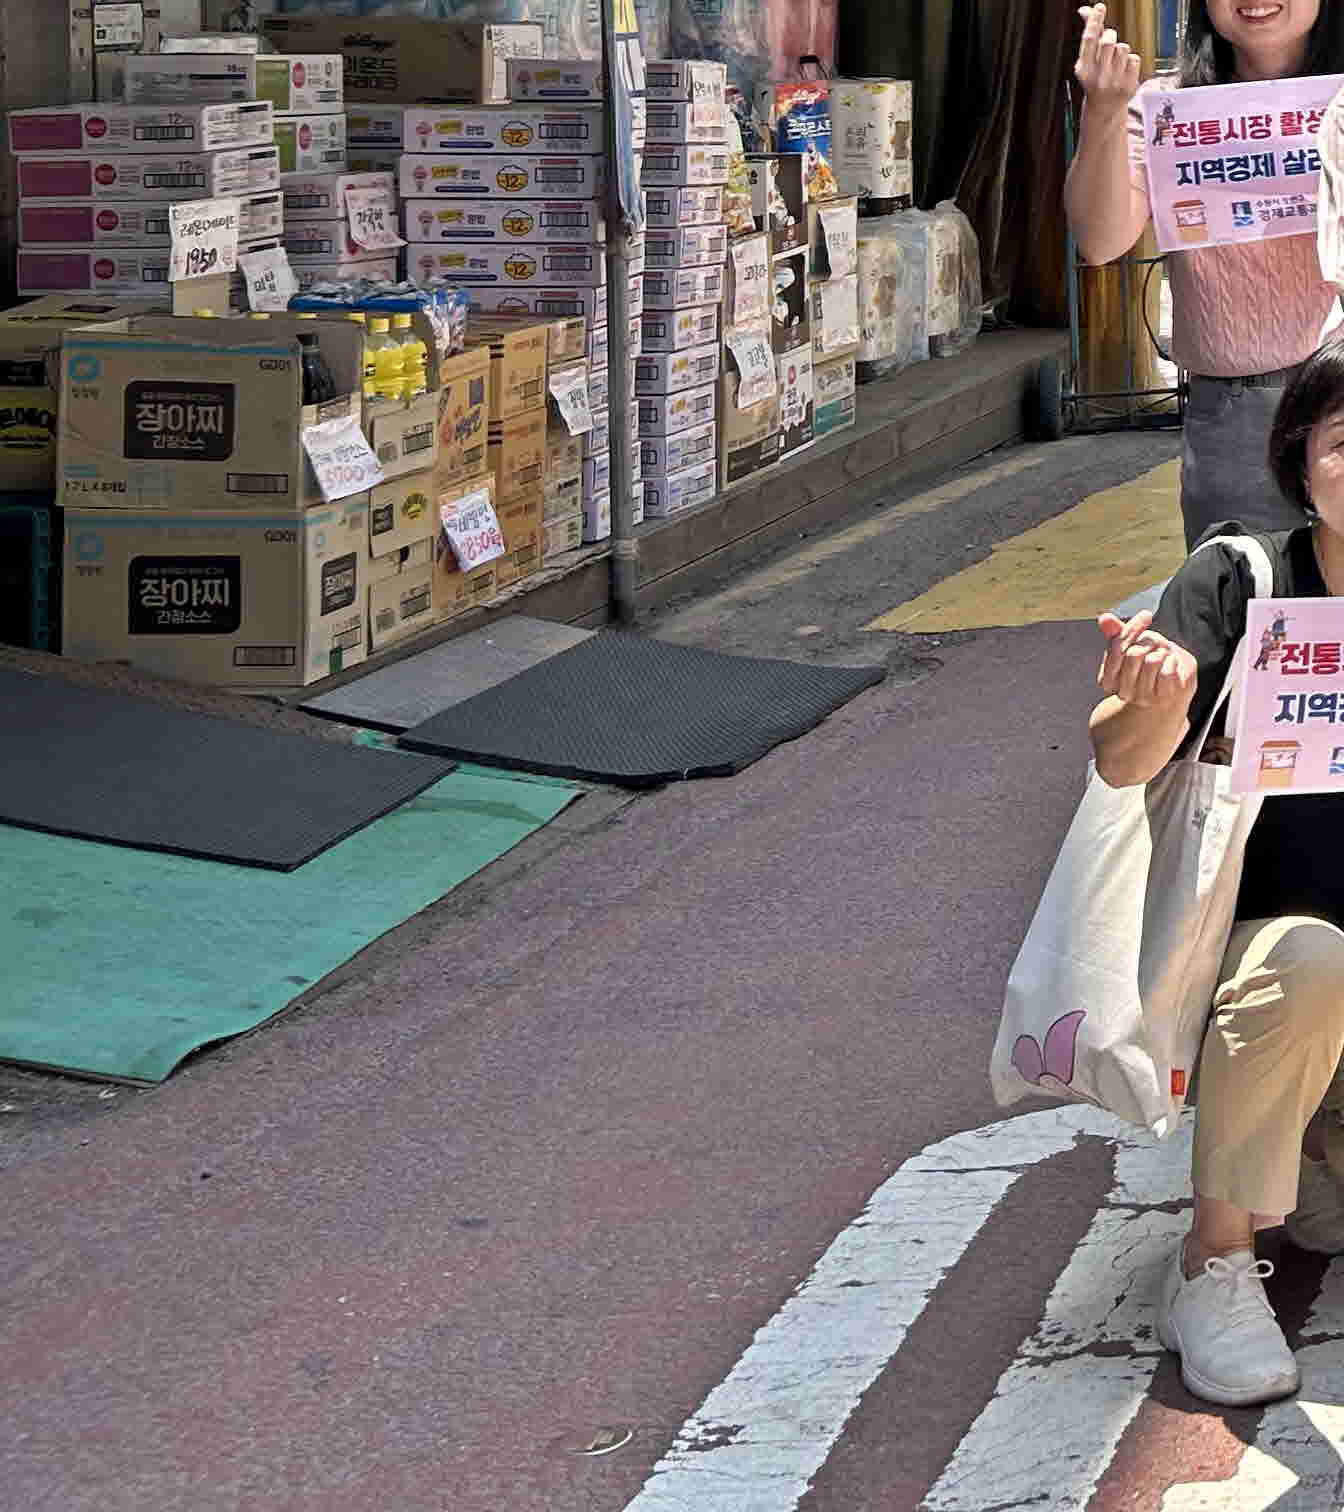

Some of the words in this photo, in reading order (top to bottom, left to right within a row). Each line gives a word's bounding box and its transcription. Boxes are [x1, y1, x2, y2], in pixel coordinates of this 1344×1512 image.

[1172, 114, 1273, 148] 전통시장
[1280, 107, 1328, 137] 활성
[1175, 151, 1276, 186] 지역경제
[135, 403, 224, 434] 장아찌
[139, 577, 231, 608] 장아찌
